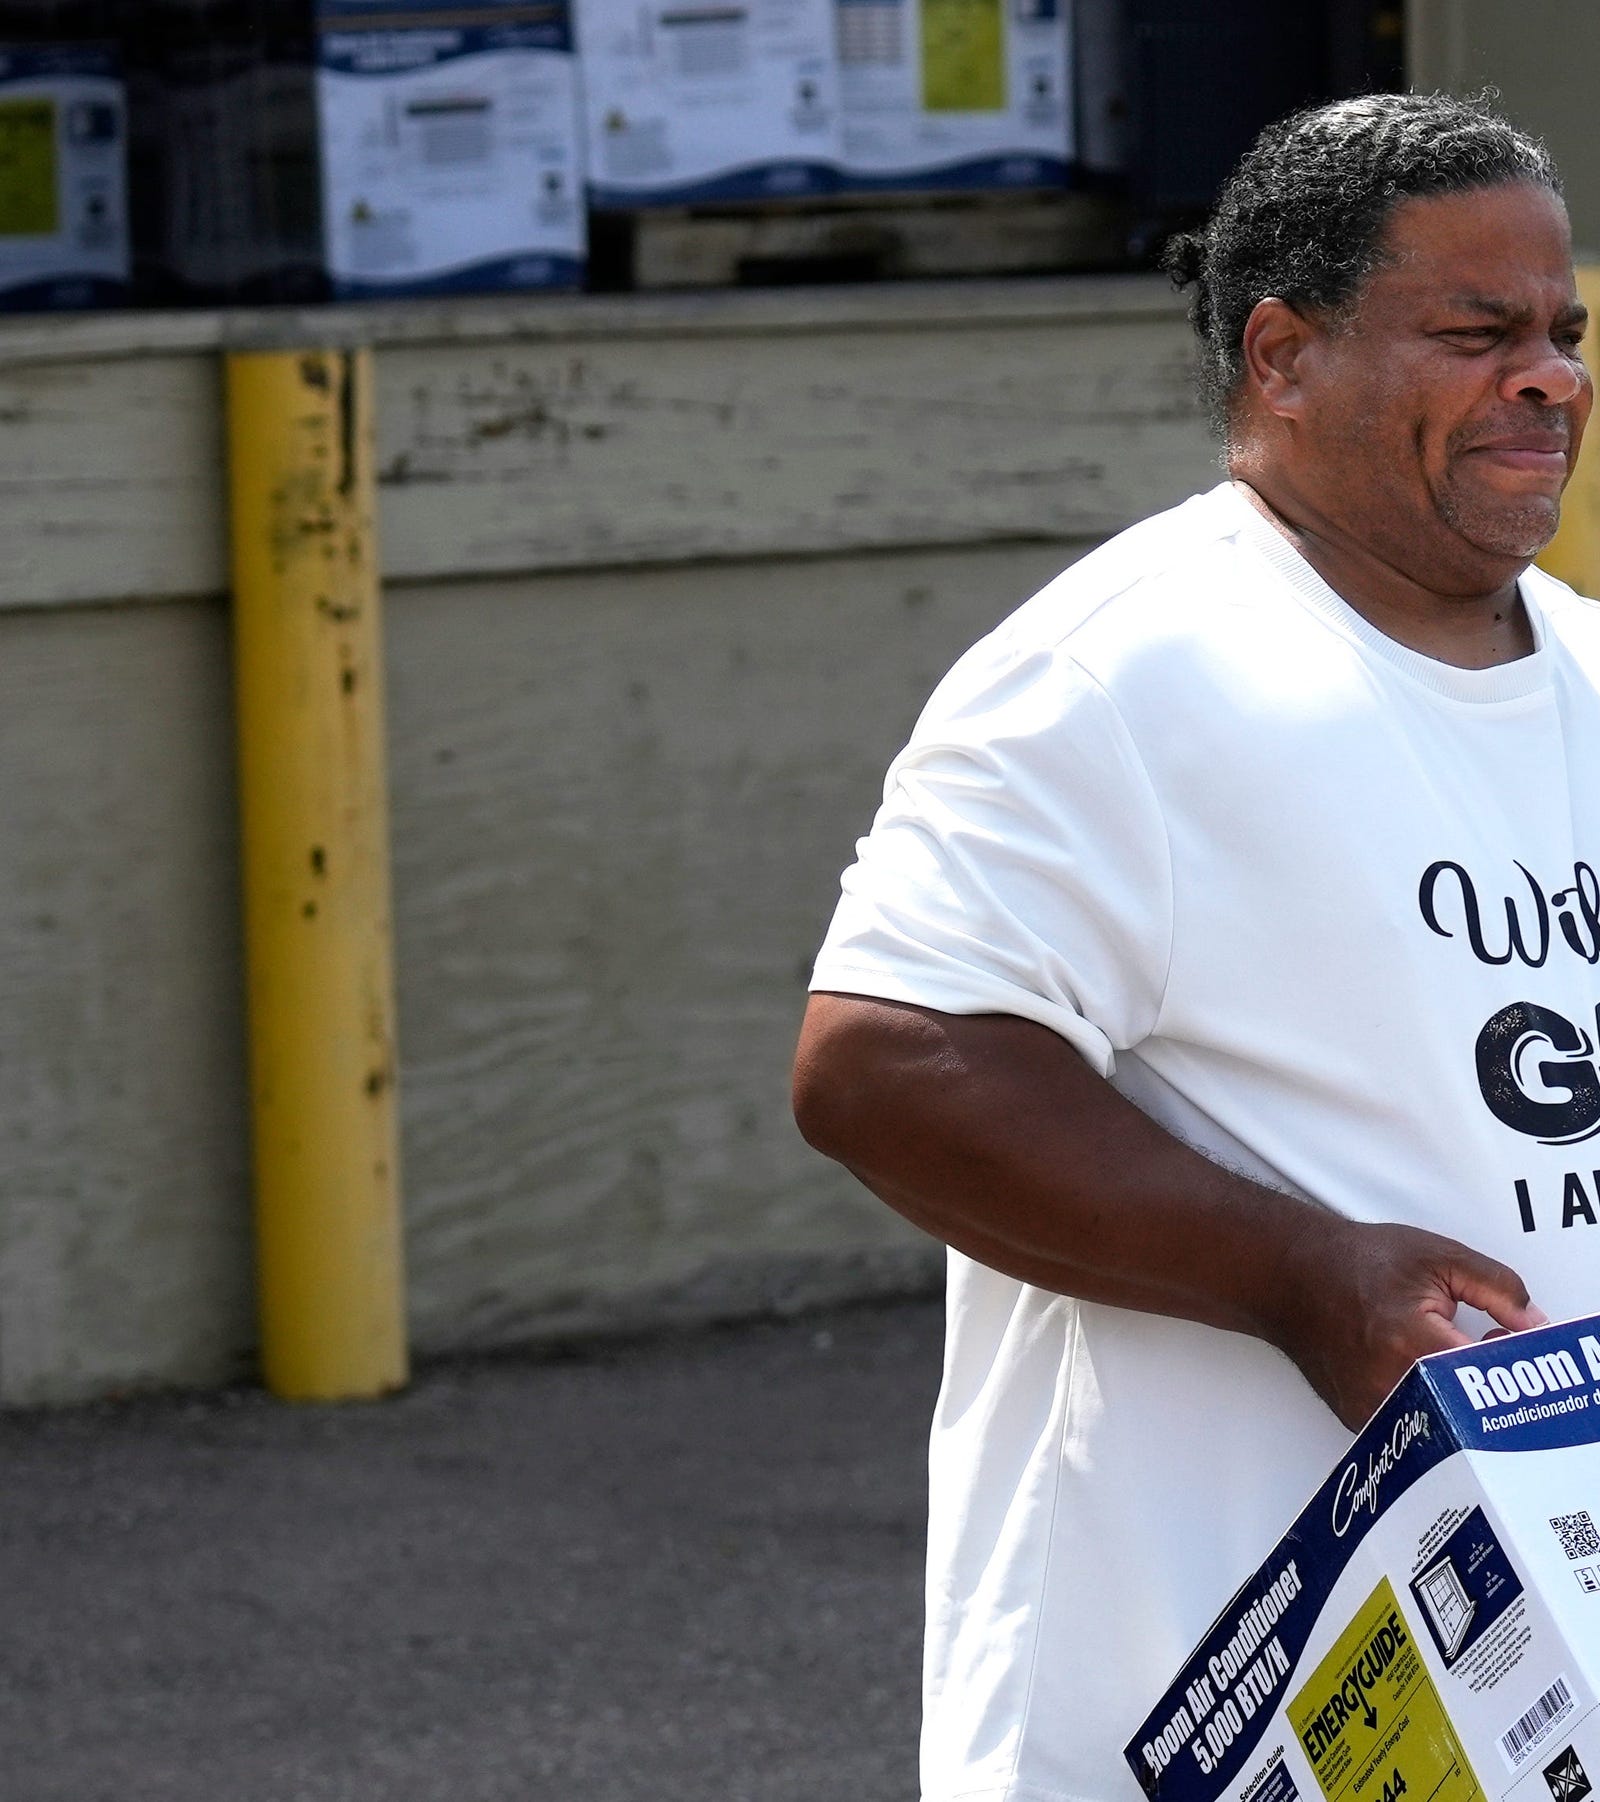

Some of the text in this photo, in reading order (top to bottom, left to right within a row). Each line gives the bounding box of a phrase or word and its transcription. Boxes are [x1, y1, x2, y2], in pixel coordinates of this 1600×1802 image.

[1514, 1178, 1536, 1232] I
[1455, 1346, 1573, 1411] Room
[1481, 1396, 1590, 1433] Acondicionador
[1142, 1559, 1303, 1779] Room Air Conditioner
[1303, 1611, 1407, 1765] ENERGYGUIDE
[1191, 1698, 1243, 1774] 5,000
[1234, 1635, 1291, 1720] BTU/H
[1384, 1729, 1401, 1752] Energy
[1398, 1715, 1410, 1732] Cost
[1239, 1766, 1269, 1802] Selection
[1265, 1744, 1285, 1770] Guide
[1377, 1767, 1407, 1802] 44
